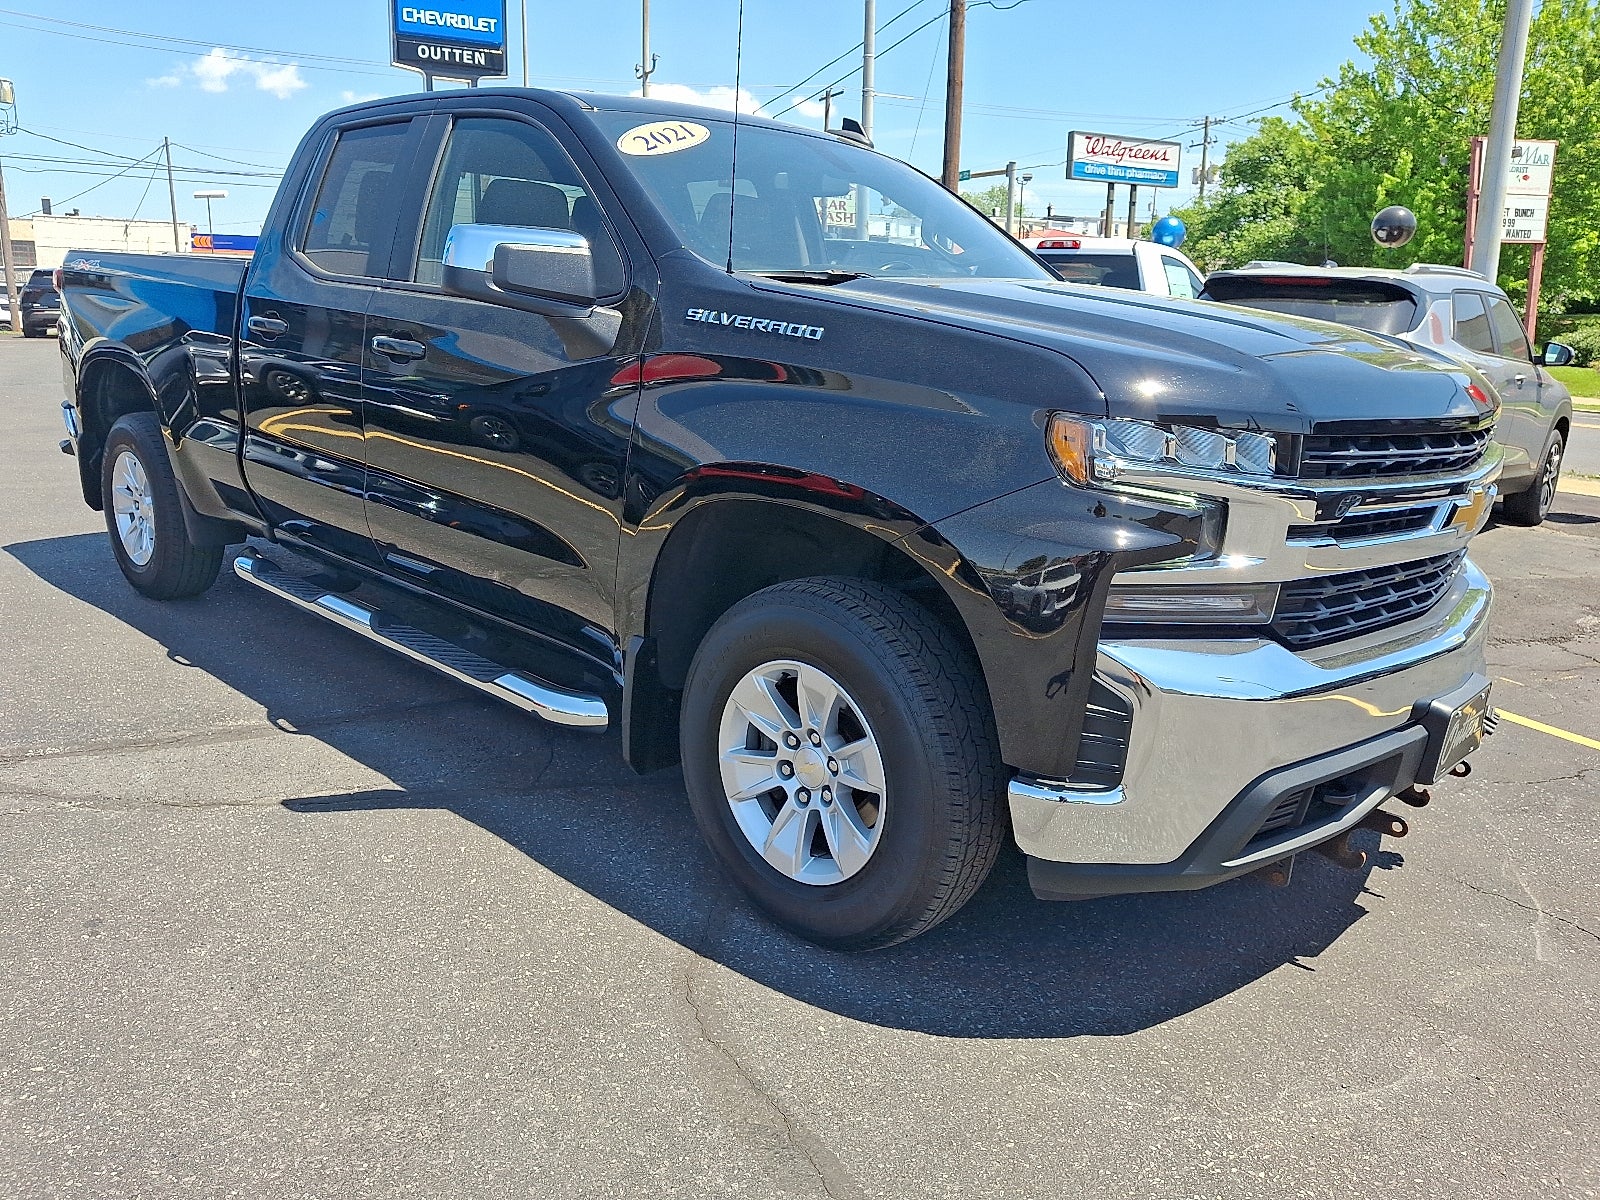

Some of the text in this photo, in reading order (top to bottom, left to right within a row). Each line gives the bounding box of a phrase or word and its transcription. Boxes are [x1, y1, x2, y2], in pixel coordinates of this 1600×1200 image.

[402, 7, 498, 33] CHEVROLET
[417, 45, 486, 66] OUTTEN
[633, 124, 695, 151] 2021
[1084, 135, 1170, 164] Walgreens
[1084, 164, 1168, 182] drive thru pharmacy
[1514, 208, 1535, 218] BUNCH
[1505, 229, 1532, 239] WANTED
[685, 308, 825, 340] SILVERADO
